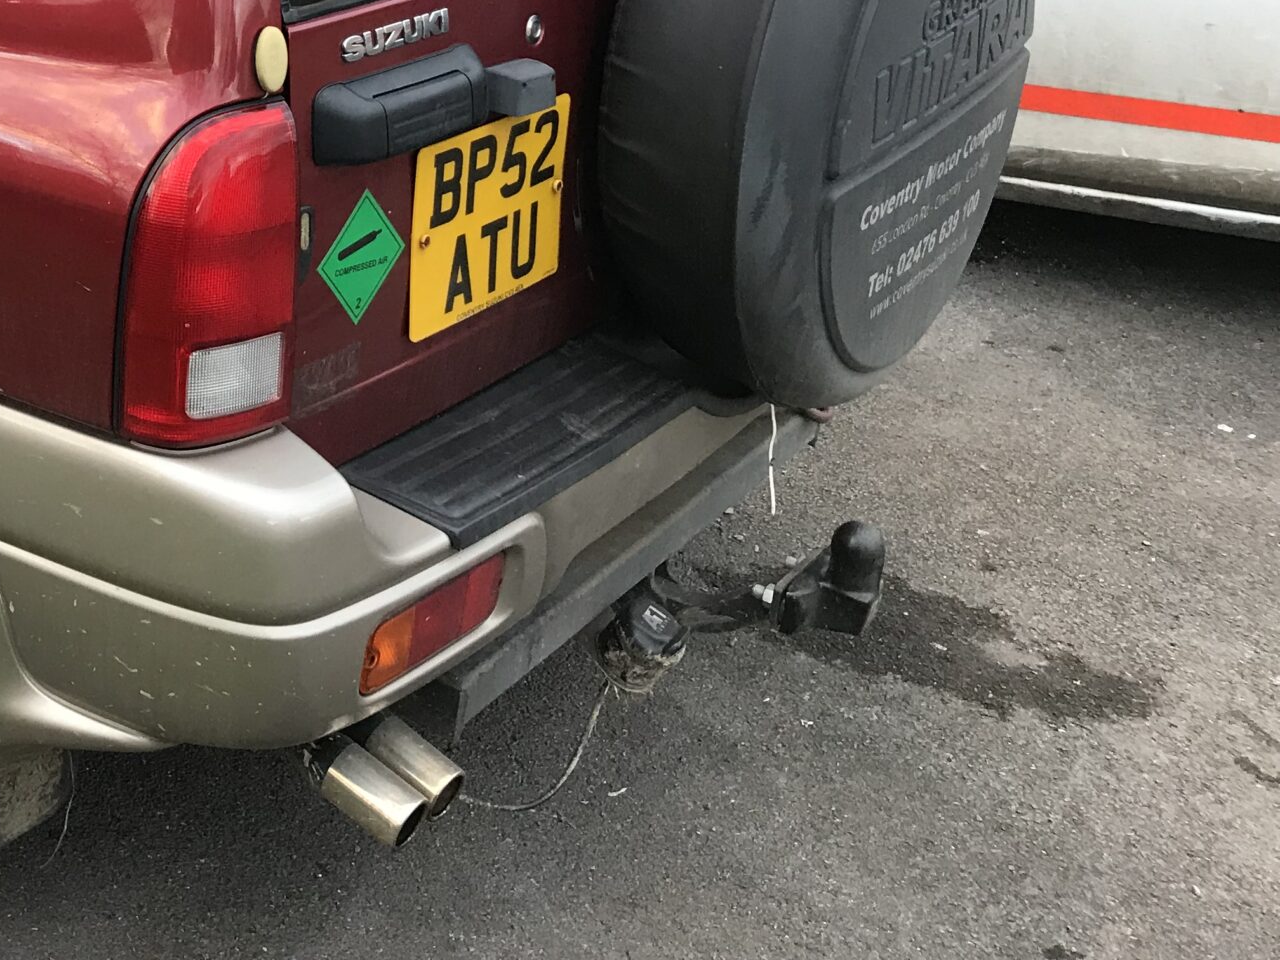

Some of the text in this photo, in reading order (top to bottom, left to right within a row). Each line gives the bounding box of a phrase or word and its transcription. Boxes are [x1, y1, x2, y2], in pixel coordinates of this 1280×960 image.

[341, 7, 449, 63] SUZUKI
[429, 109, 559, 229] BP52
[860, 107, 1008, 231] Coventry Motor Company
[334, 259, 377, 277] COMPRESSED
[444, 201, 538, 314] ATU
[869, 189, 980, 298] Tel: 02476 639 100
[355, 297, 362, 310] 2
